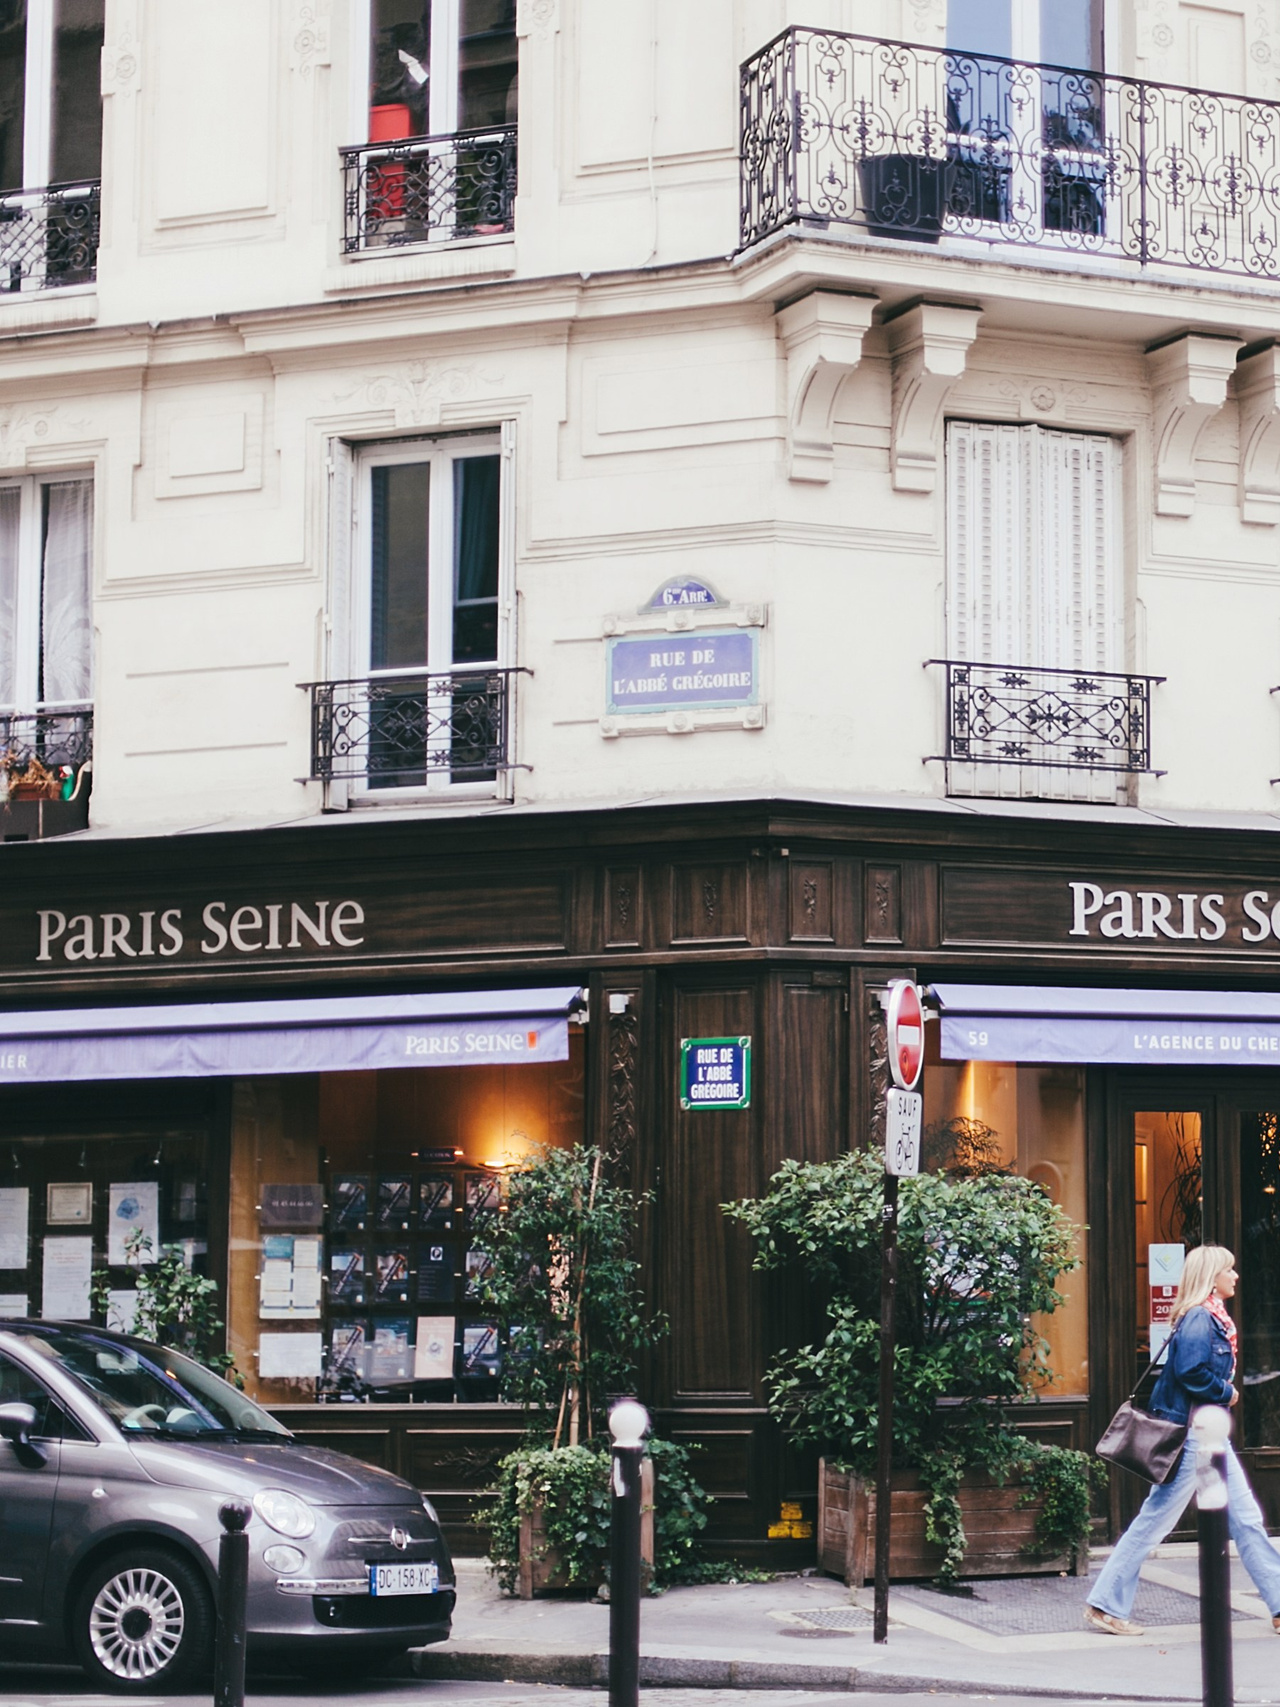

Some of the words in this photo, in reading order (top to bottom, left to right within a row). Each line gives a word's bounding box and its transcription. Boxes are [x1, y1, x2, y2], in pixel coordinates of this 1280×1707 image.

[650, 651, 685, 667] RUE
[692, 649, 715, 665] DE
[613, 674, 667, 695] L'ABBÉ
[672, 670, 751, 691] GRÉGOIRE
[968, 1031, 988, 1046] 59
[1133, 1034, 1216, 1050] L'AGENCE
[1220, 1036, 1243, 1051] DU
[697, 1048, 718, 1063] RUE
[720, 1047, 734, 1063] DE
[698, 1064, 733, 1081] L'ABBÉ
[690, 1081, 740, 1099] GRÉGOIRE
[898, 1097, 917, 1117] SAUF
